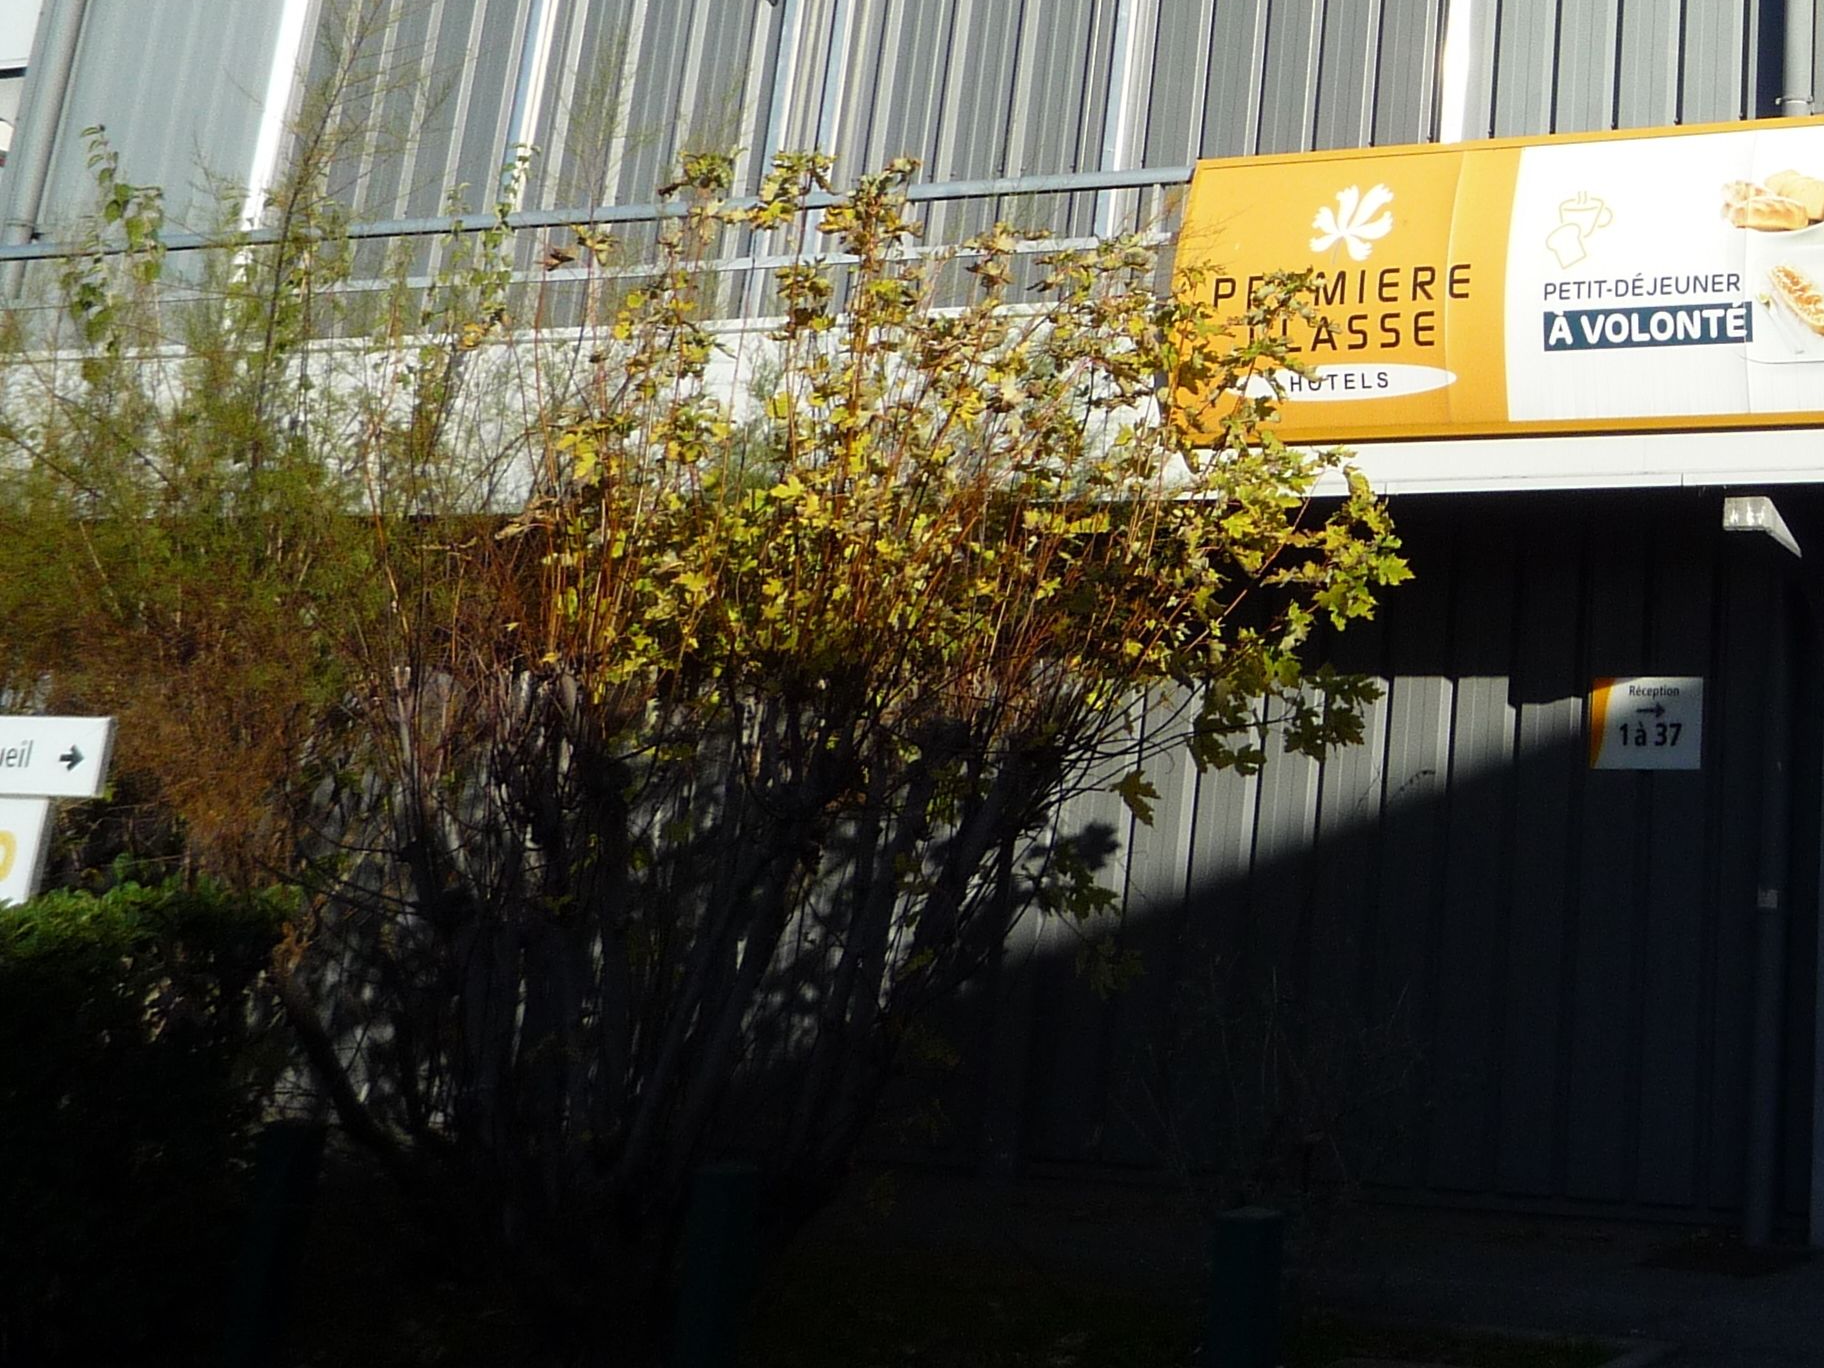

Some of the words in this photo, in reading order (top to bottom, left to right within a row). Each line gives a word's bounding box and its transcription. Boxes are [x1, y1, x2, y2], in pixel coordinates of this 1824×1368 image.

[1543, 273, 1741, 301] PETIT-DÉJEUNER
[1580, 303, 1747, 344] VOLONTÉ
[1629, 685, 1680, 699] Réception
[1620, 723, 1628, 746] 1
[1634, 721, 1646, 746] à
[1654, 723, 1682, 746] 37
